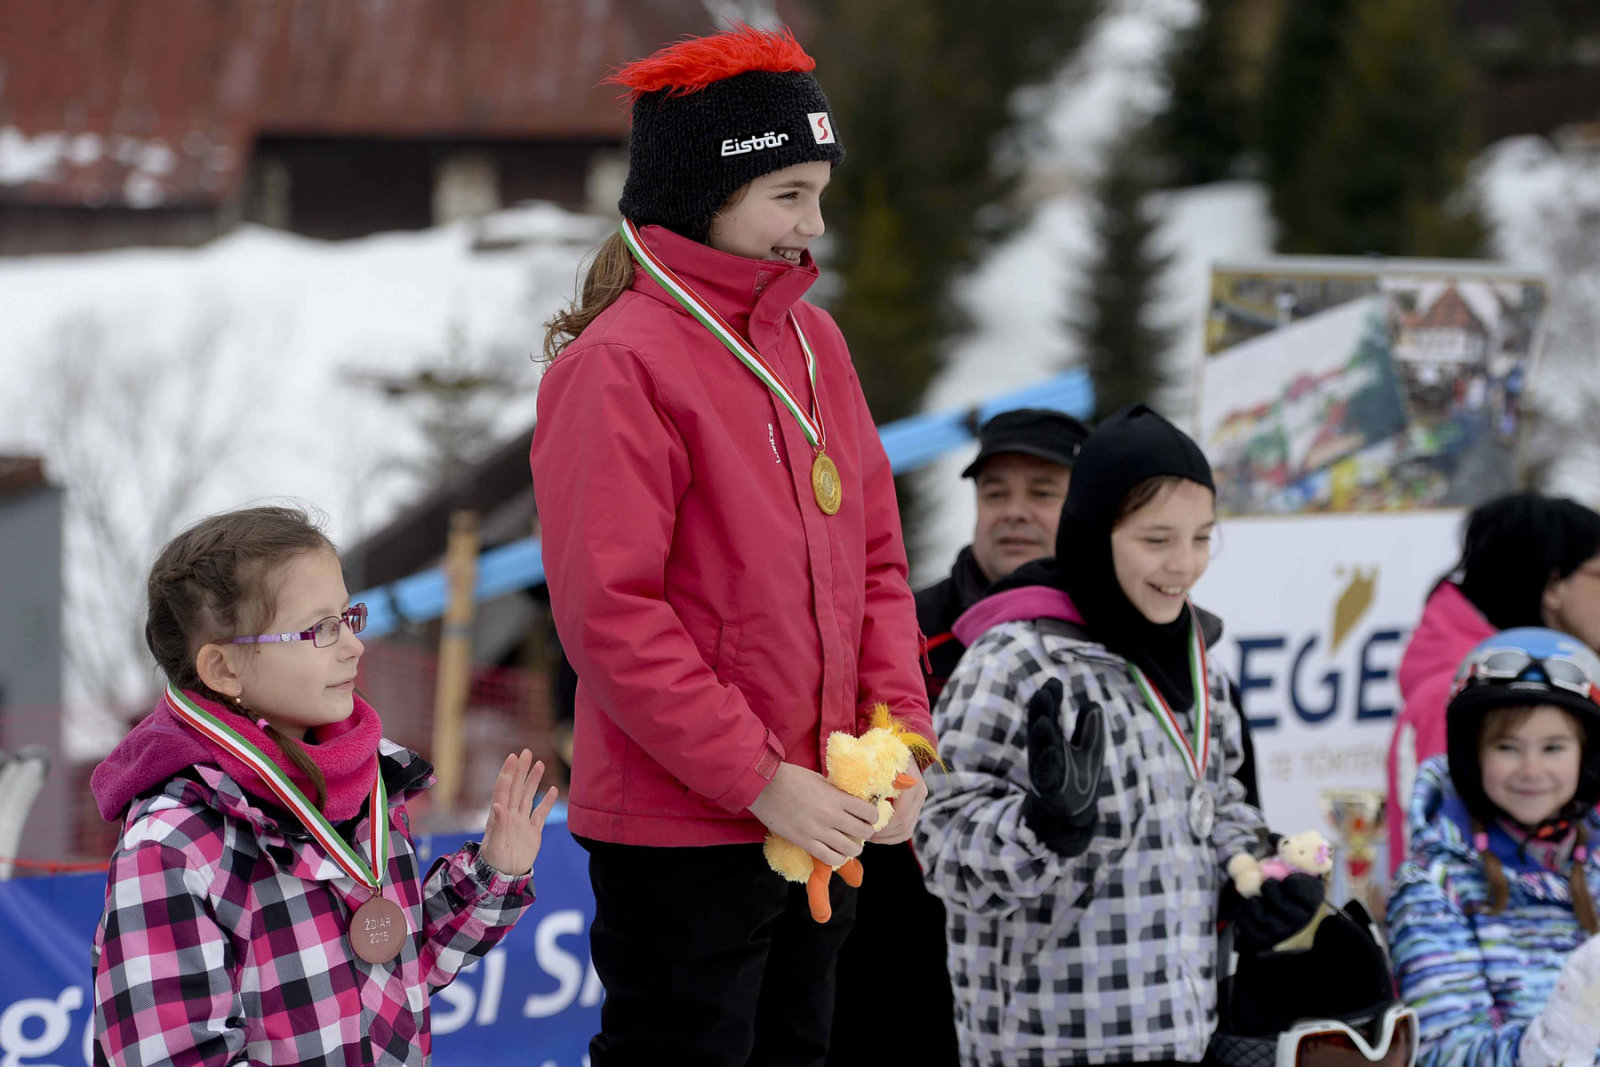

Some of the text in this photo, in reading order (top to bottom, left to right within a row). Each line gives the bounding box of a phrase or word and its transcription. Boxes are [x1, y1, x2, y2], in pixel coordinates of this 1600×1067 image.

[721, 131, 789, 157] Eisbär
[1235, 629, 1404, 730] EGE
[369, 931, 389, 944] 2015
